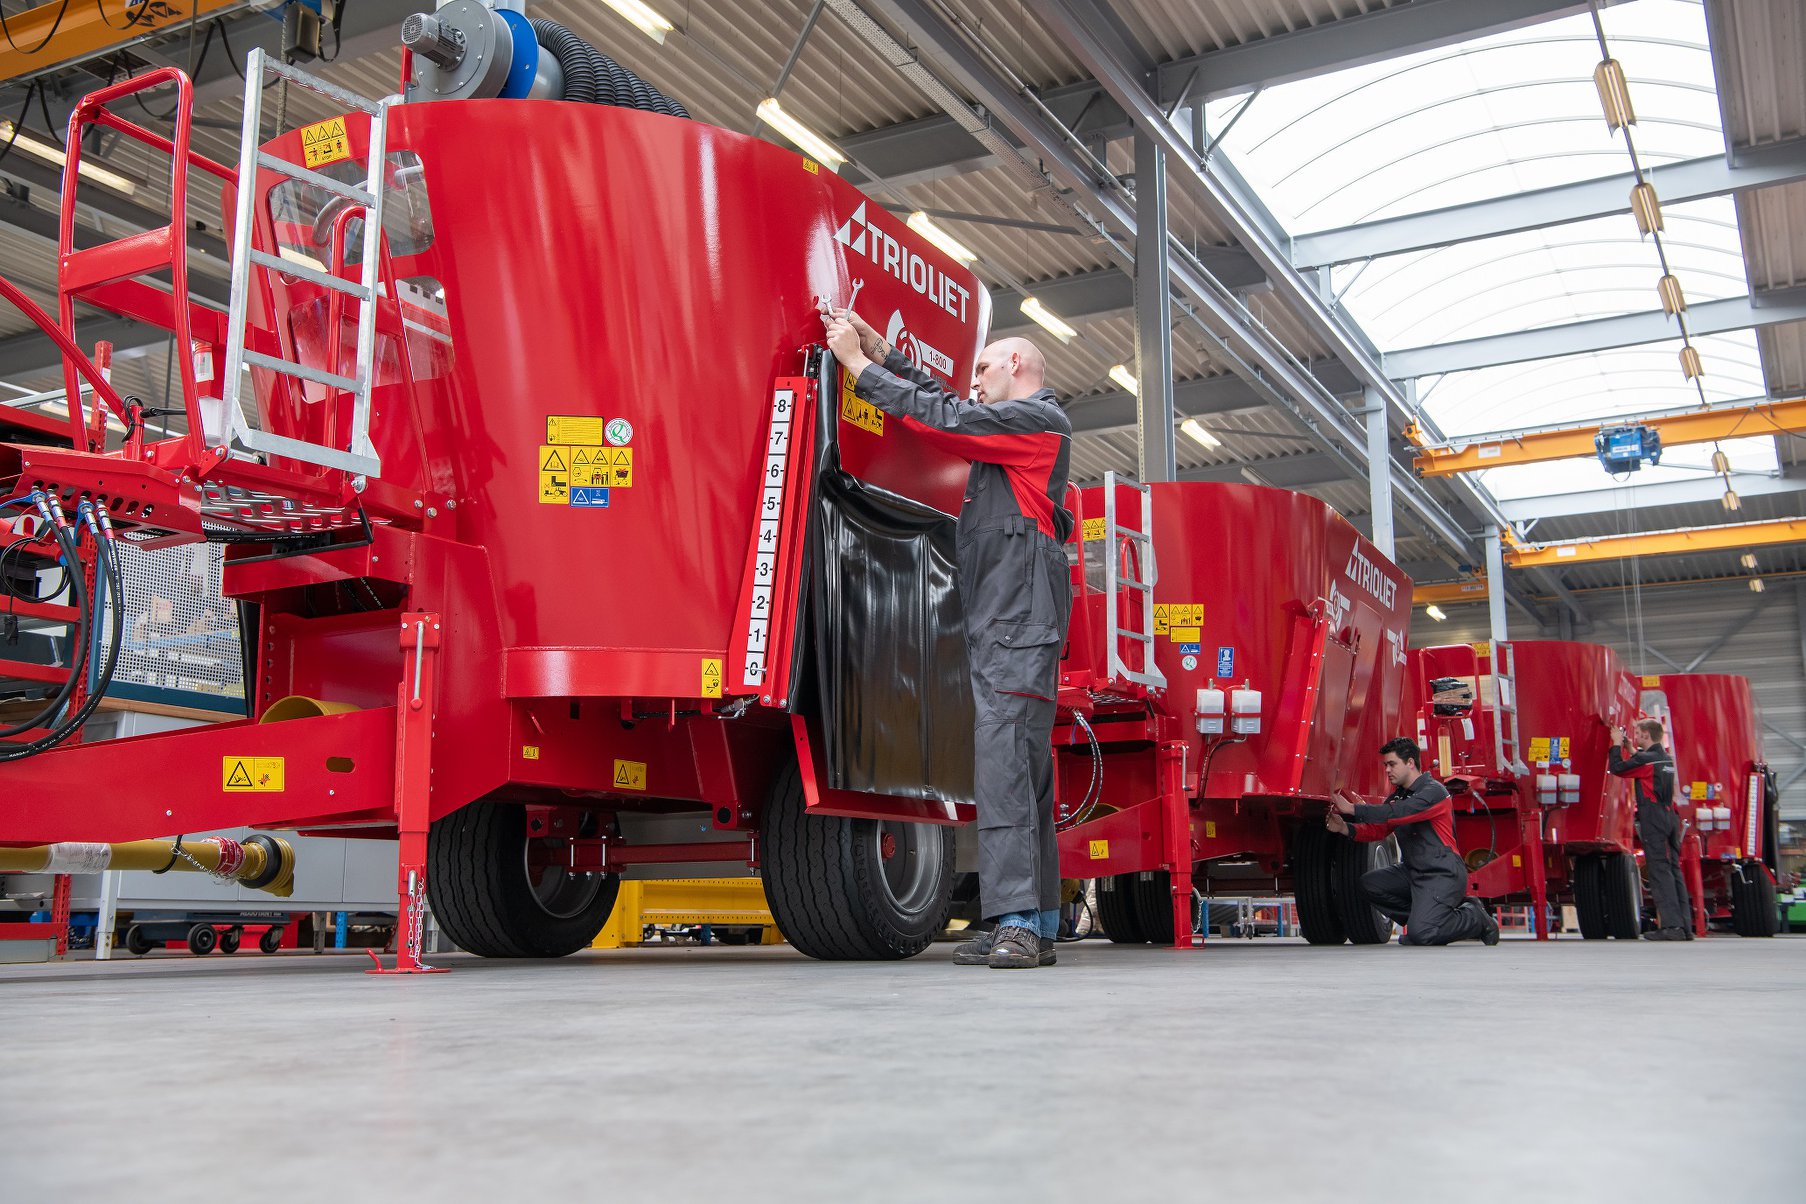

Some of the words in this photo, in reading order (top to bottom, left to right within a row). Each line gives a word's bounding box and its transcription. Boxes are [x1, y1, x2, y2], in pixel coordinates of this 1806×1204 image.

[867, 220, 970, 324] TRIOLIET
[777, 398, 786, 412] 8
[774, 432, 784, 446] 7
[770, 464, 780, 478] 6
[766, 497, 776, 510] 5
[763, 529, 772, 544] 4
[760, 562, 768, 576] 3
[1357, 551, 1397, 612] TRIOLIET
[756, 596, 766, 610] 2
[753, 628, 760, 642] 1
